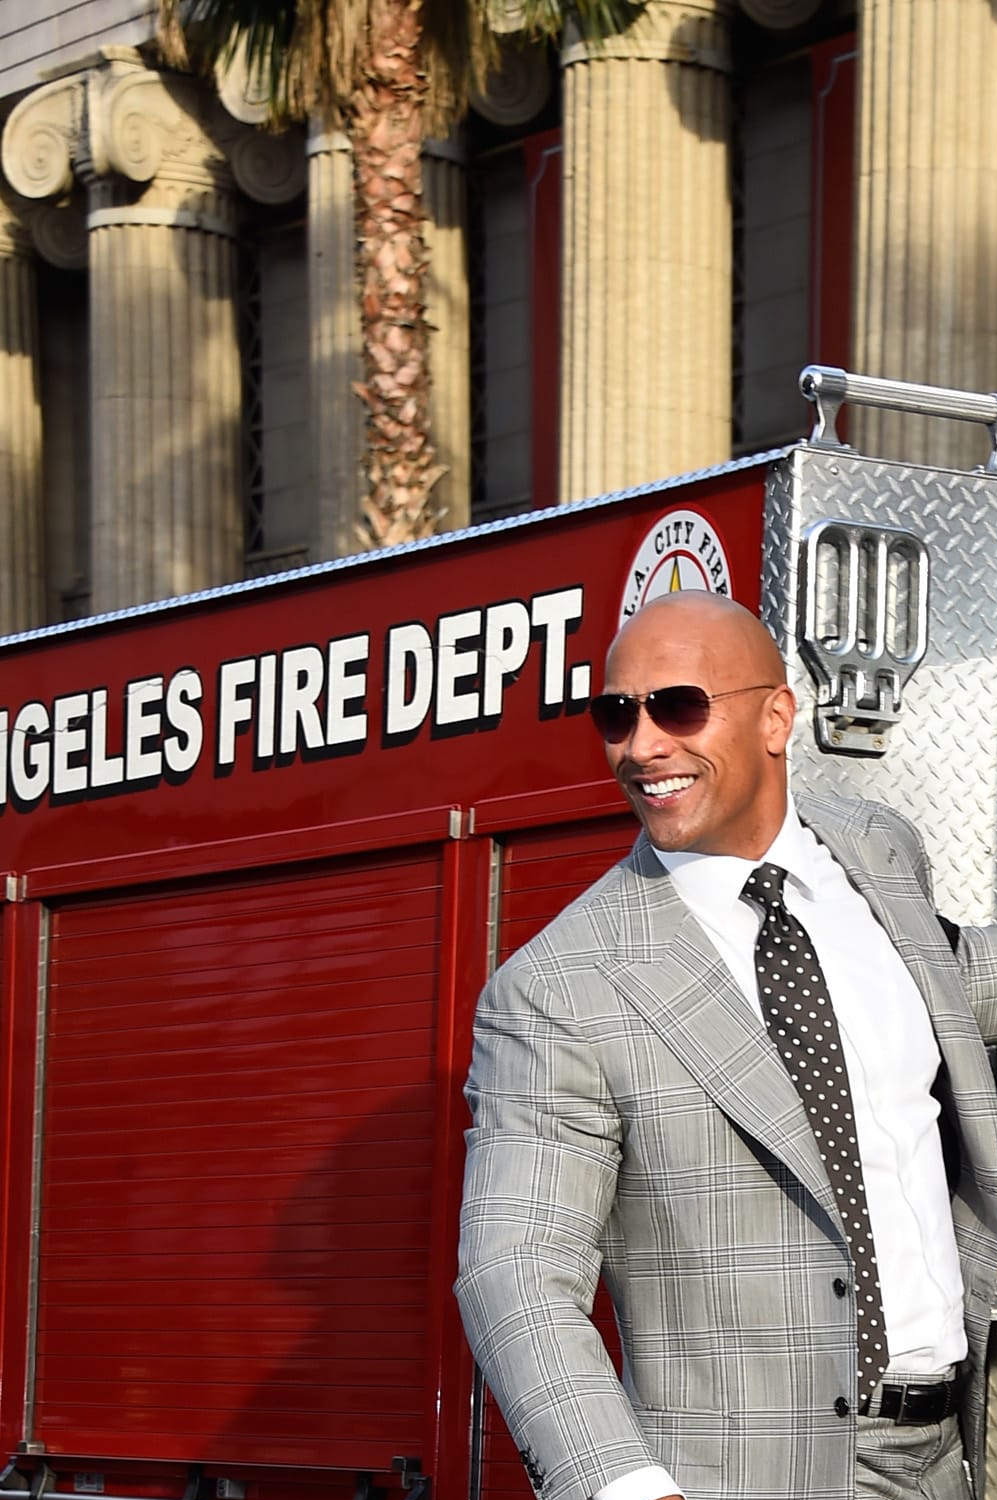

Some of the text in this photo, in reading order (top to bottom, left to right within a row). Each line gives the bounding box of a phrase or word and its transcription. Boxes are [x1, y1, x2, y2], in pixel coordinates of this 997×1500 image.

[623, 566, 650, 617] L.A.
[654, 520, 695, 555] CITY
[0, 587, 591, 804] GELES FIRE DEPT.
